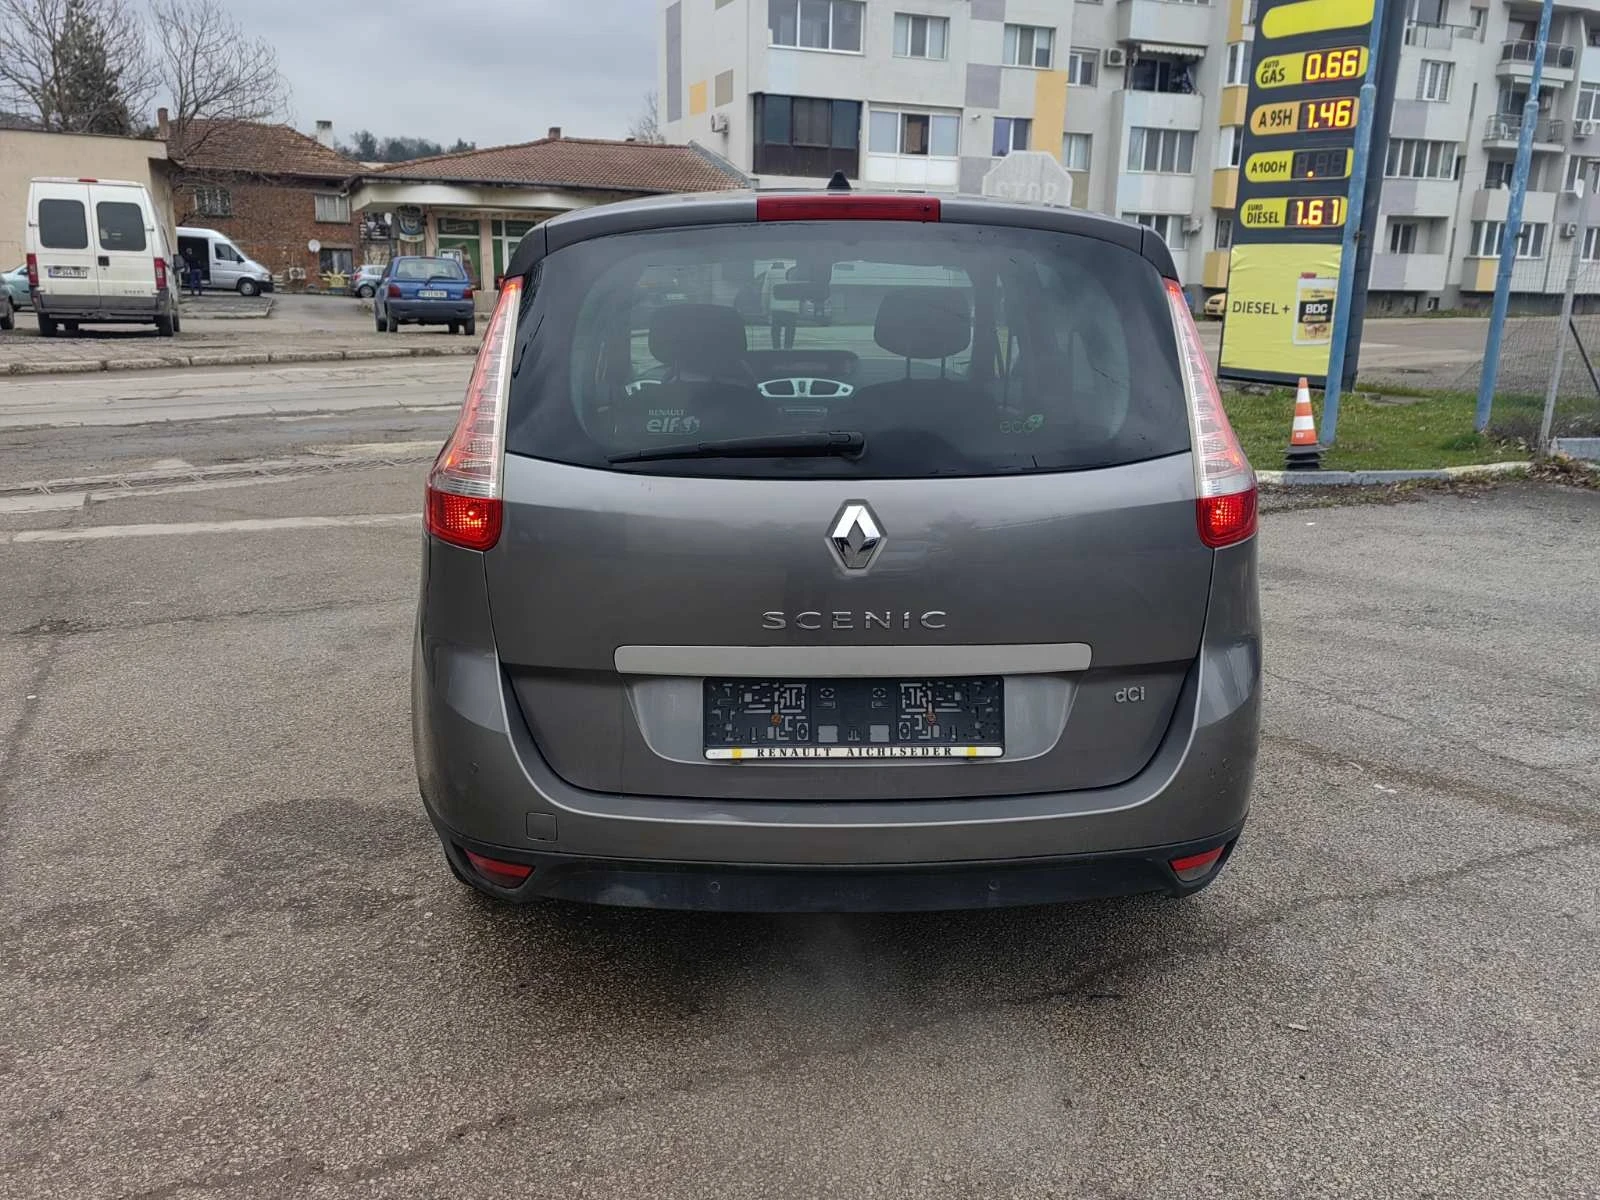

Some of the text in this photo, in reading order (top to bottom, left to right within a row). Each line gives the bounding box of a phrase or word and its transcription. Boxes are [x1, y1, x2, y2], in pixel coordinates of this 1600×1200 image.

[1305, 49, 1359, 80] 0.66
[1261, 67, 1285, 84] GAS
[1258, 109, 1293, 128] A 95H
[1307, 100, 1352, 128] 1.46
[1246, 211, 1280, 225] DIESEL
[1296, 199, 1340, 226] 1.61
[1232, 300, 1280, 315] DIESEL
[1305, 303, 1328, 314] BDC
[647, 416, 681, 433] elf
[761, 611, 948, 630] SCENIC
[756, 746, 953, 757] RENAULT AICHLSEDER
